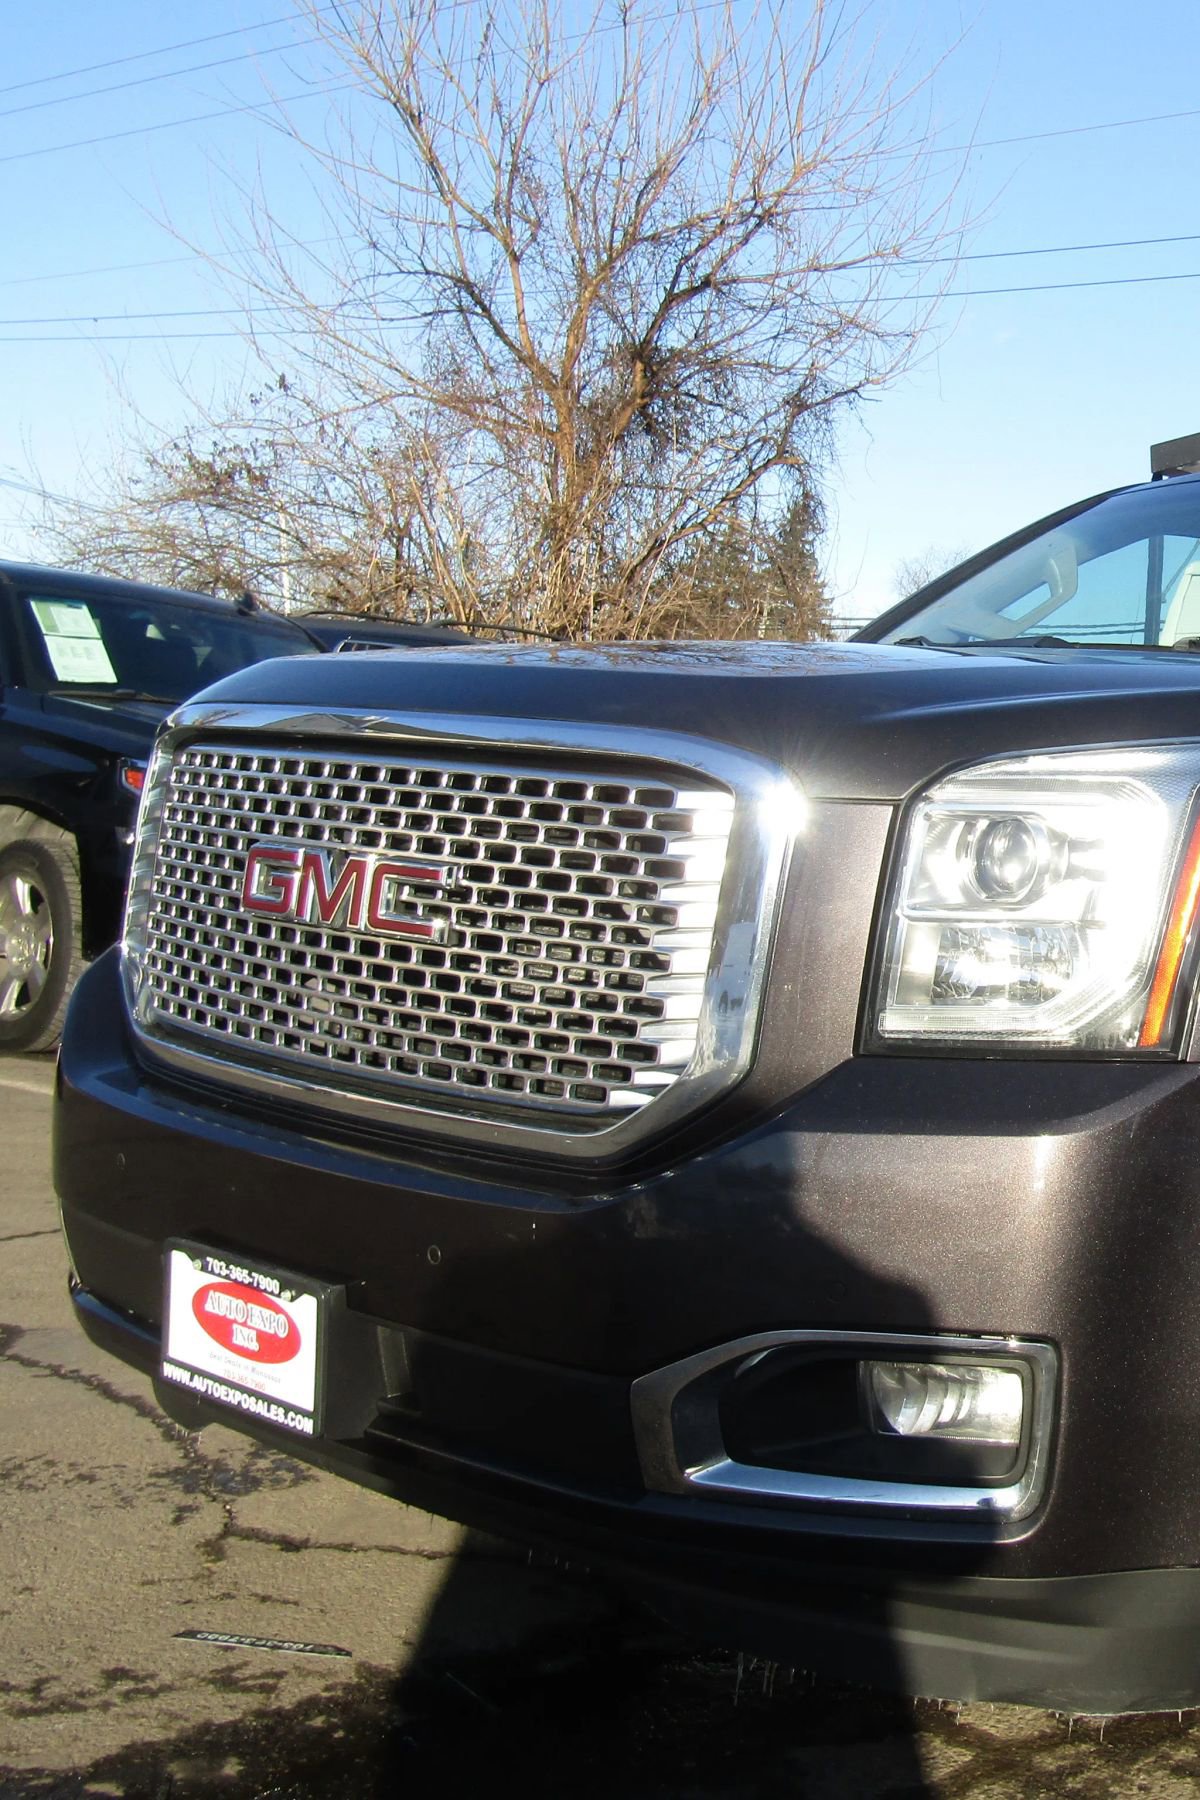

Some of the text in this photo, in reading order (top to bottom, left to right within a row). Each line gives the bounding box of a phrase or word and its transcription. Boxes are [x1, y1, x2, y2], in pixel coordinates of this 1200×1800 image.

[241, 843, 456, 944] GMC
[206, 1256, 280, 1295] 703-365-7900
[205, 1290, 289, 1338] AUTO EXPO
[232, 1323, 260, 1352] INC.
[163, 1361, 314, 1435] WWW.AUTOEXPOSALES.COM
